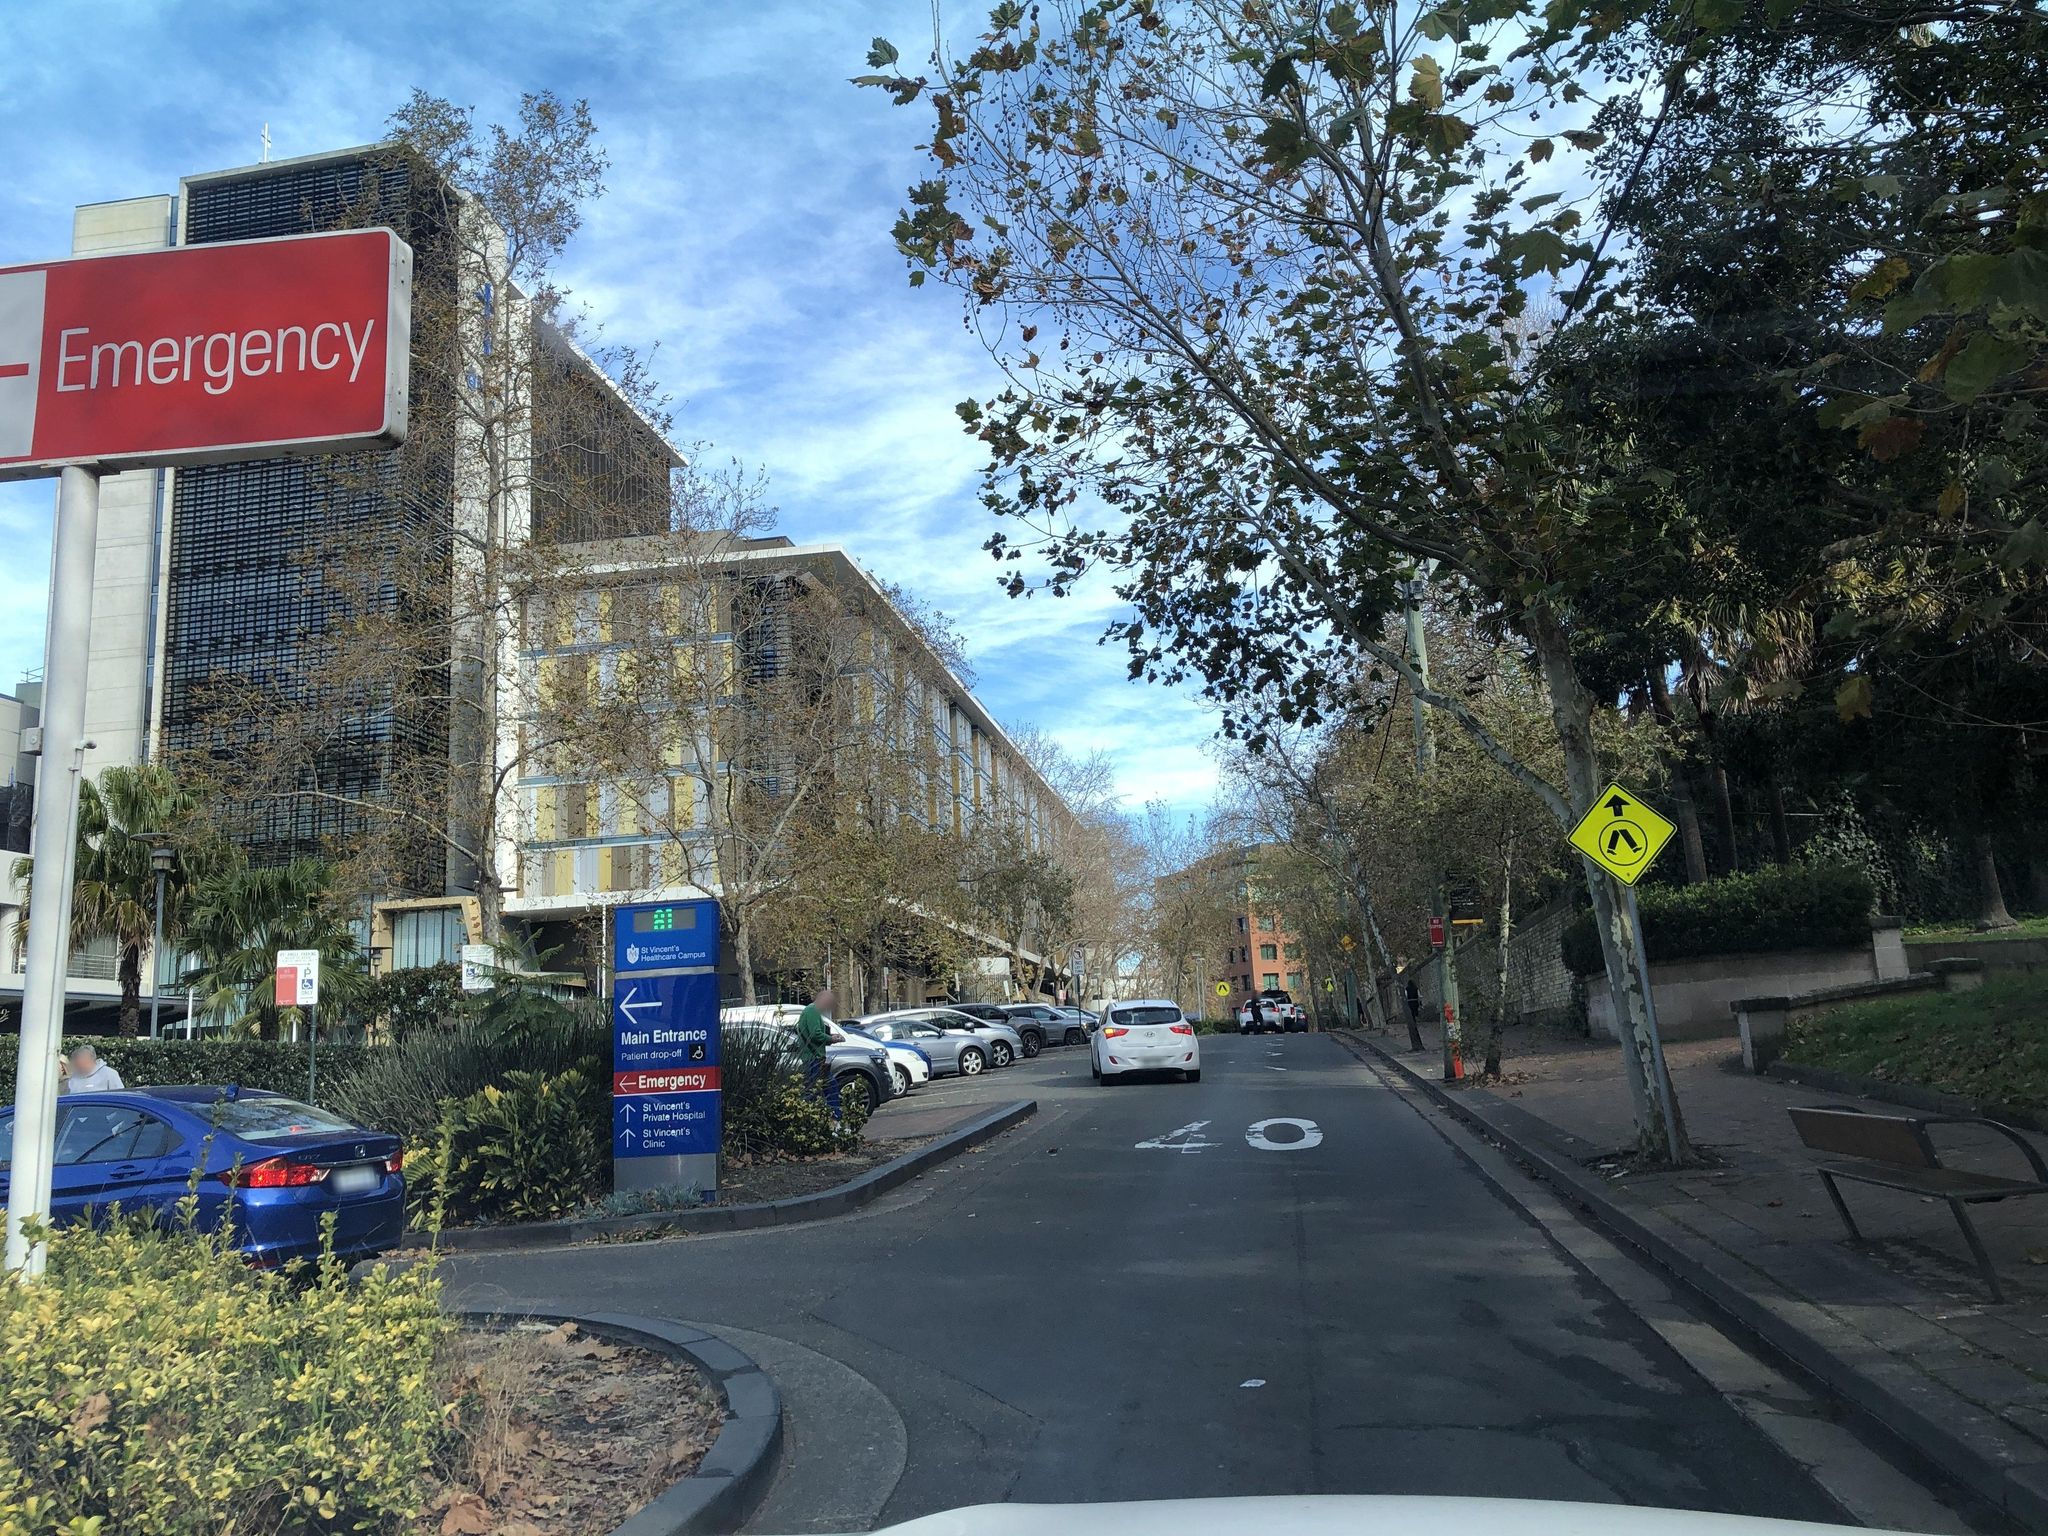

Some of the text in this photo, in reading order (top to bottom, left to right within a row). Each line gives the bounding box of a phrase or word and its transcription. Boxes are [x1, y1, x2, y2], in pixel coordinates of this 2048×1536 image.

[56, 318, 375, 395] Emergency
[650, 945, 680, 953] Vincent's
[641, 951, 706, 962] Healthcare Campus
[621, 1029, 707, 1045] Main Entrance
[621, 1048, 682, 1060] Patient drop-off
[638, 1074, 706, 1090] Emergency
[643, 1101, 690, 1112] St Vincent's
[643, 1111, 706, 1122] Private Hospital
[643, 1127, 691, 1138] St Vincent's
[643, 1140, 666, 1149] Clinic
